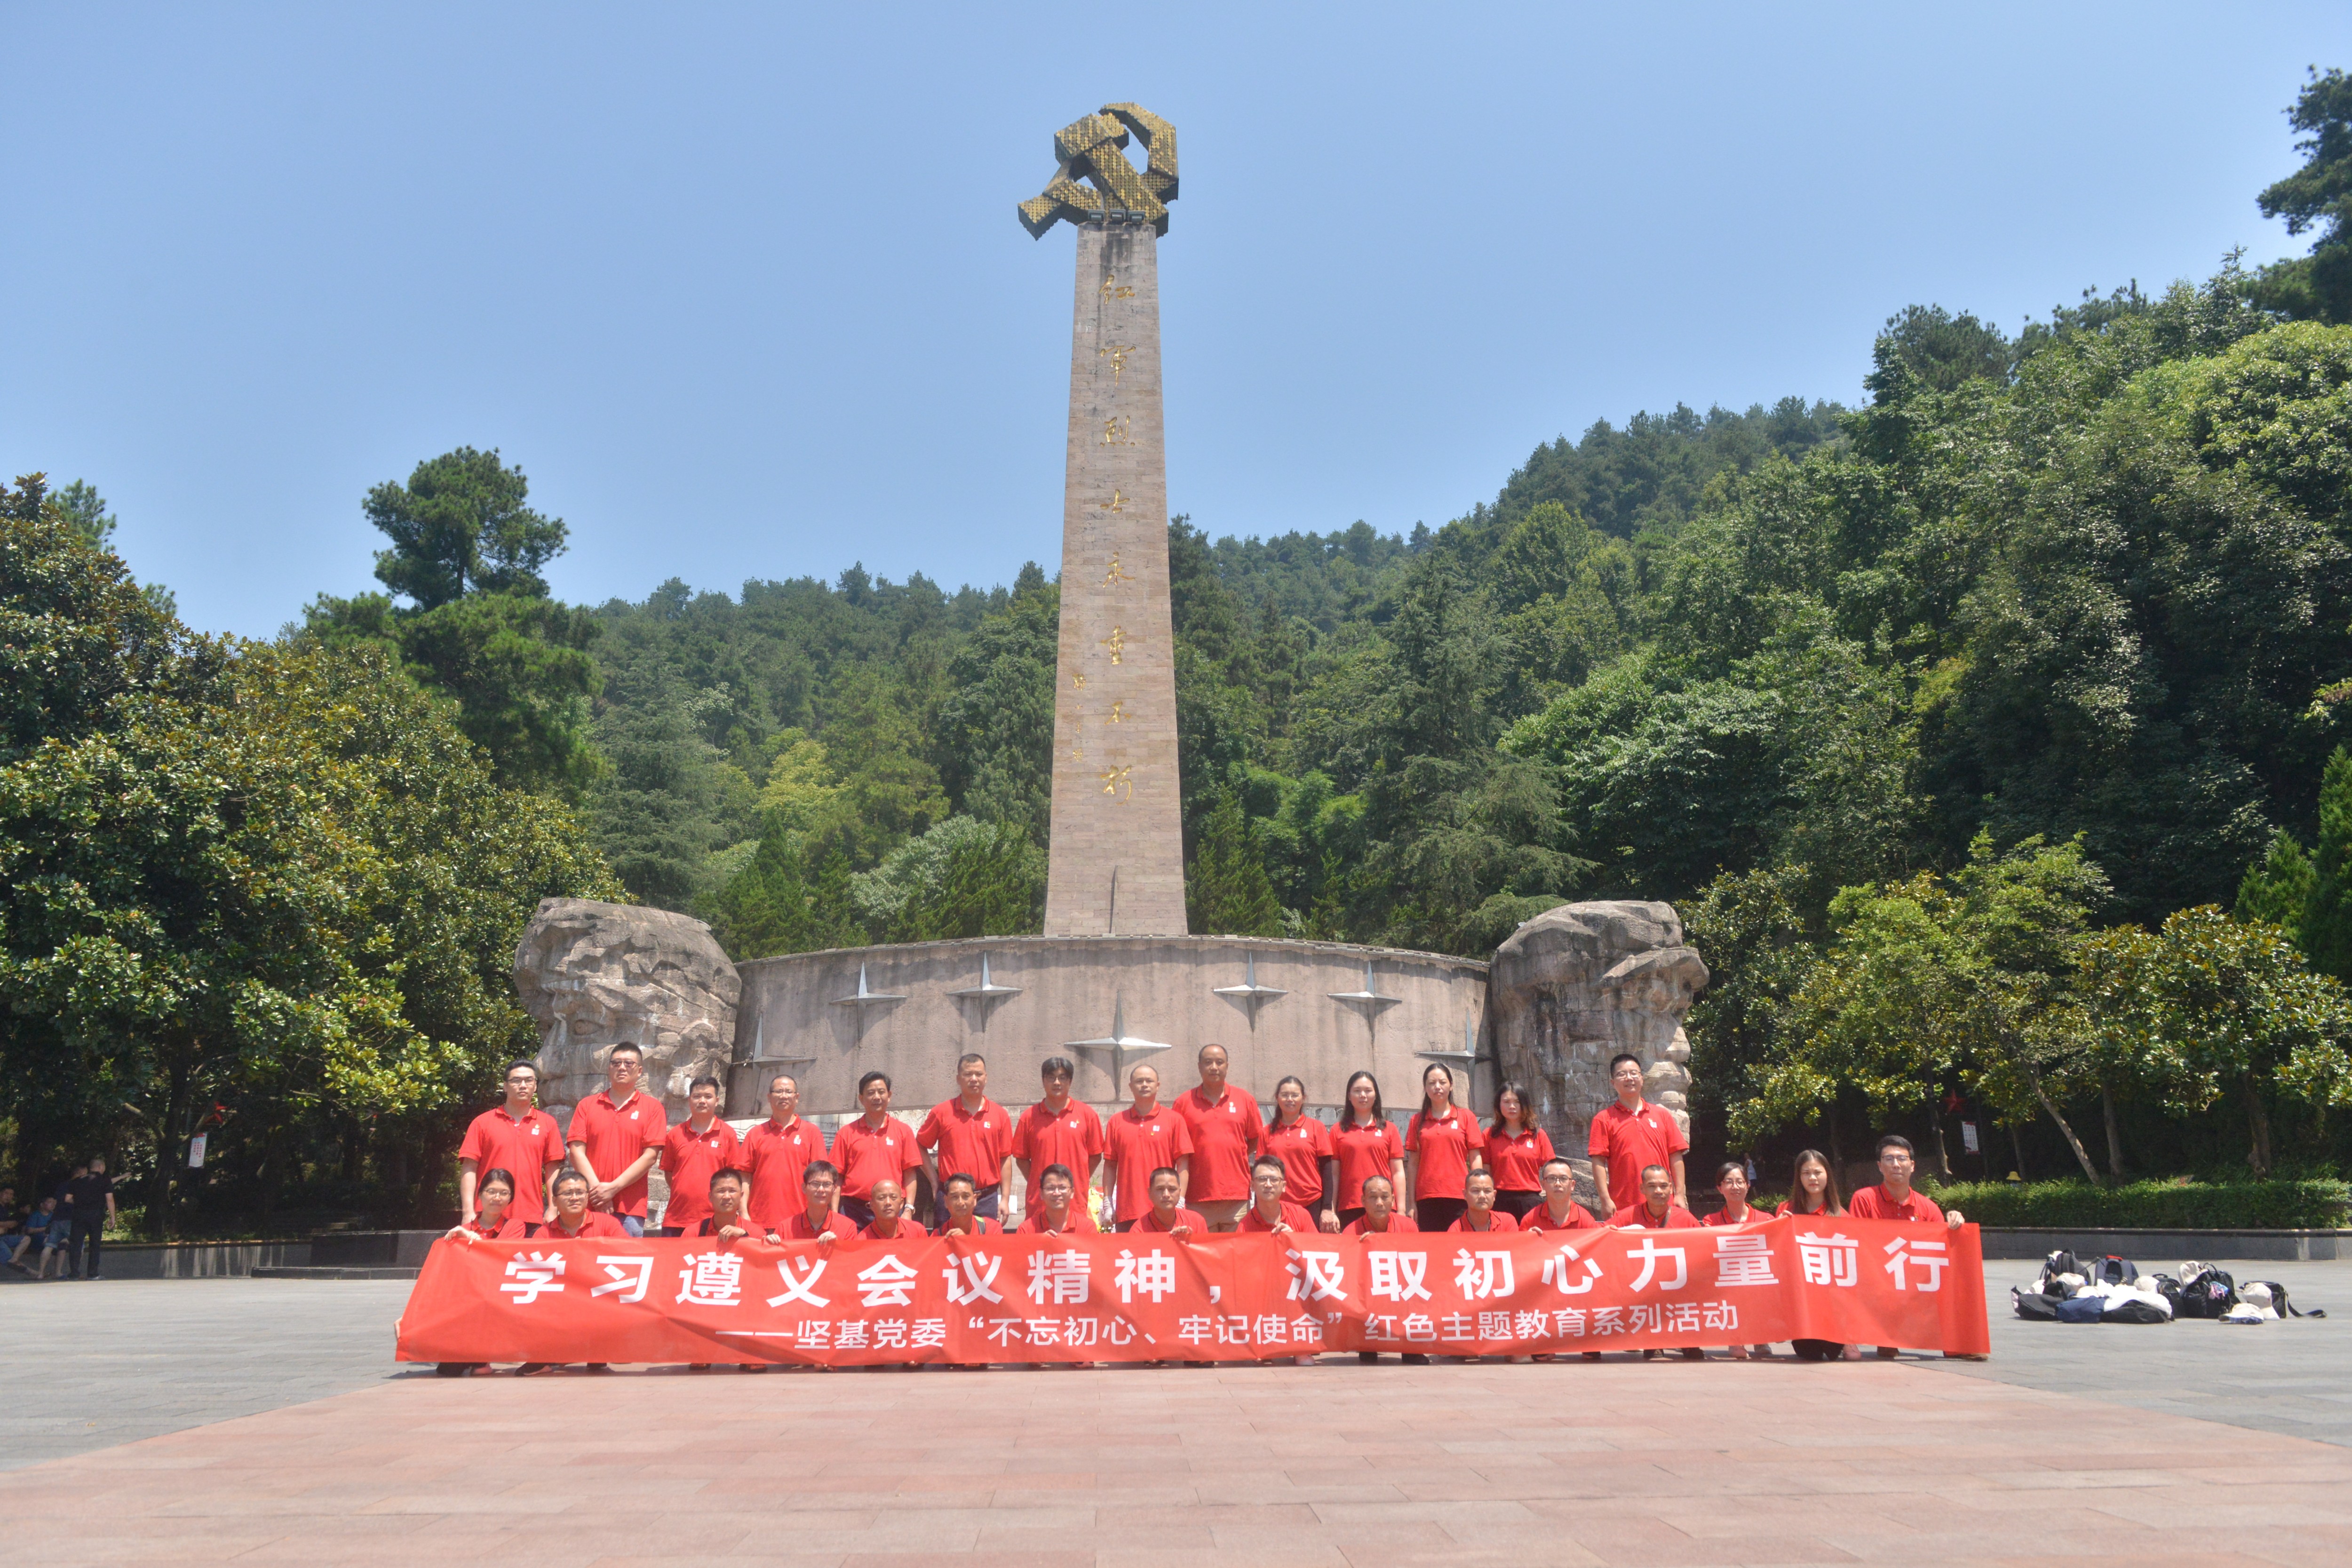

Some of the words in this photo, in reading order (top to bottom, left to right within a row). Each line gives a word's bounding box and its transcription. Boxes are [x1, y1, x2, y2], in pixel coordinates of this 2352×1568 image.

[500, 1231, 1949, 1308] 学习遵义会议精神，汲取初心力量前行
